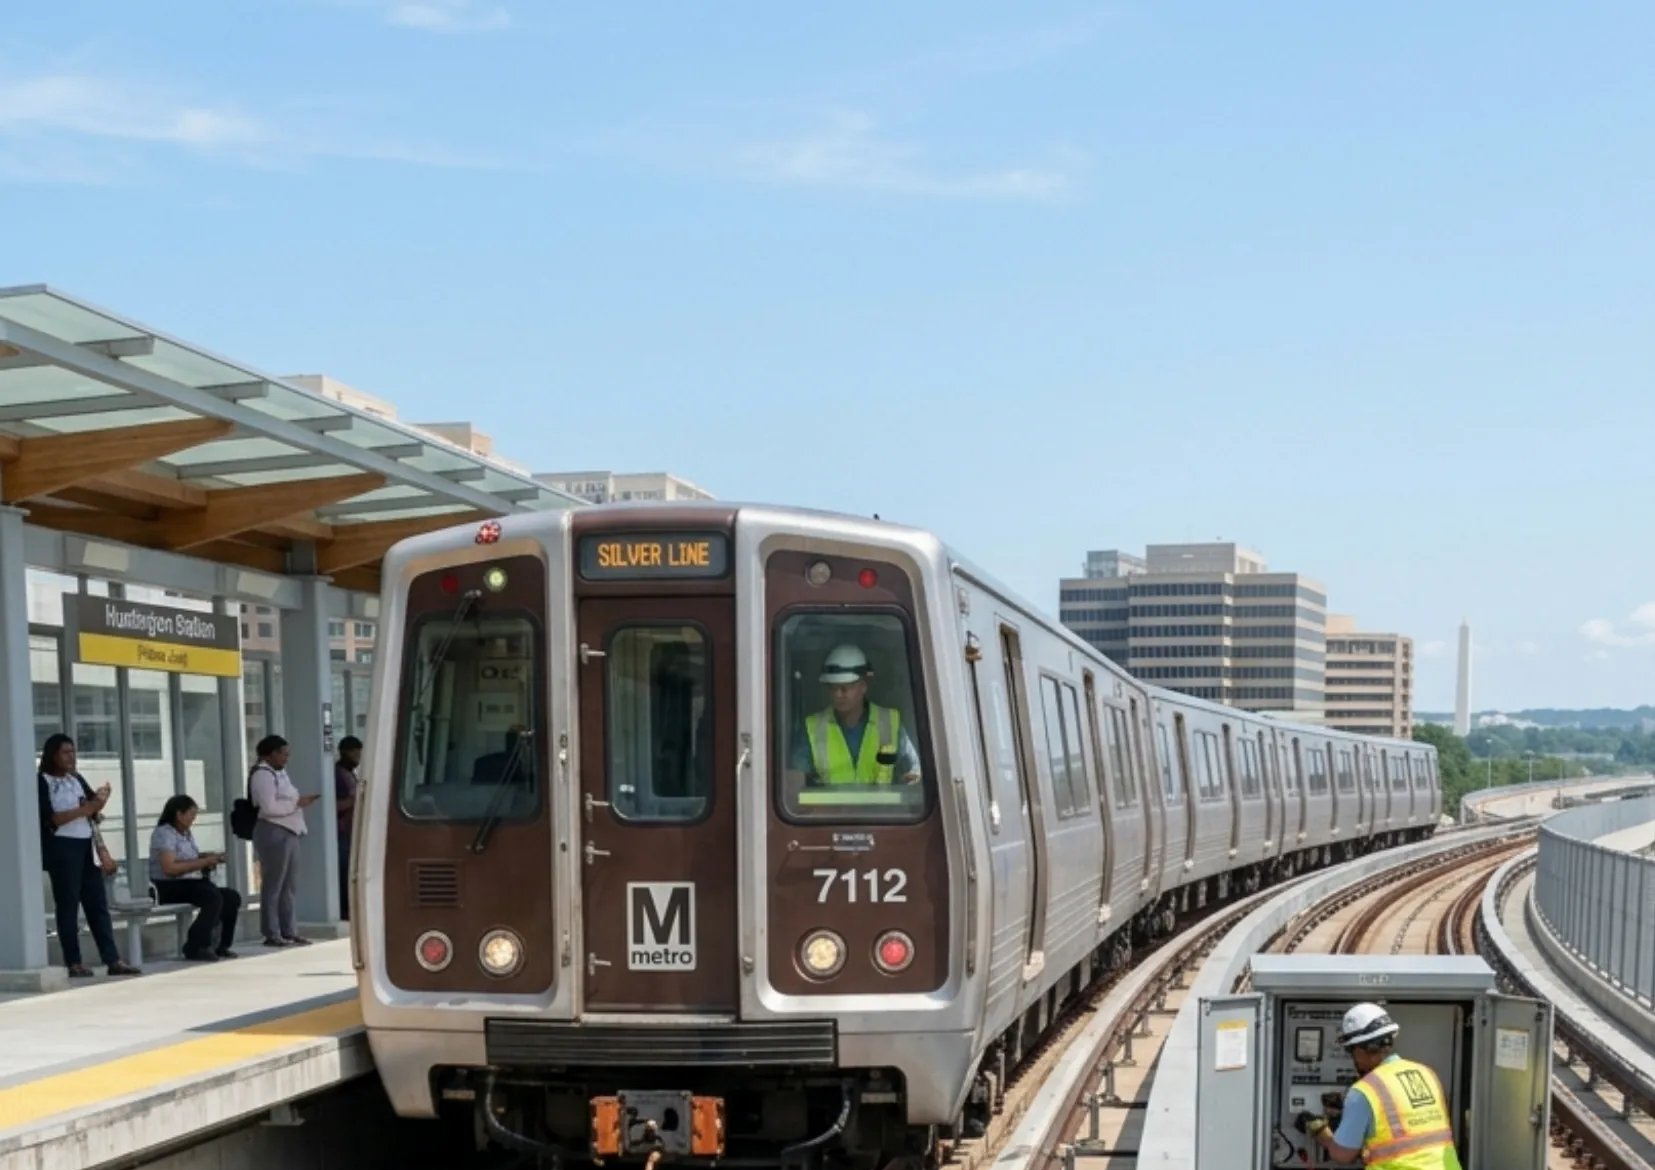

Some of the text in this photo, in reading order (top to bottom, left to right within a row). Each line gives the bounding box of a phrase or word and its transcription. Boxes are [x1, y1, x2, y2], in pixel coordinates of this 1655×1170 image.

[597, 541, 710, 567] SILVER LINE
[813, 868, 907, 903] 7112
[631, 886, 692, 945] M
[631, 948, 693, 965] metro
